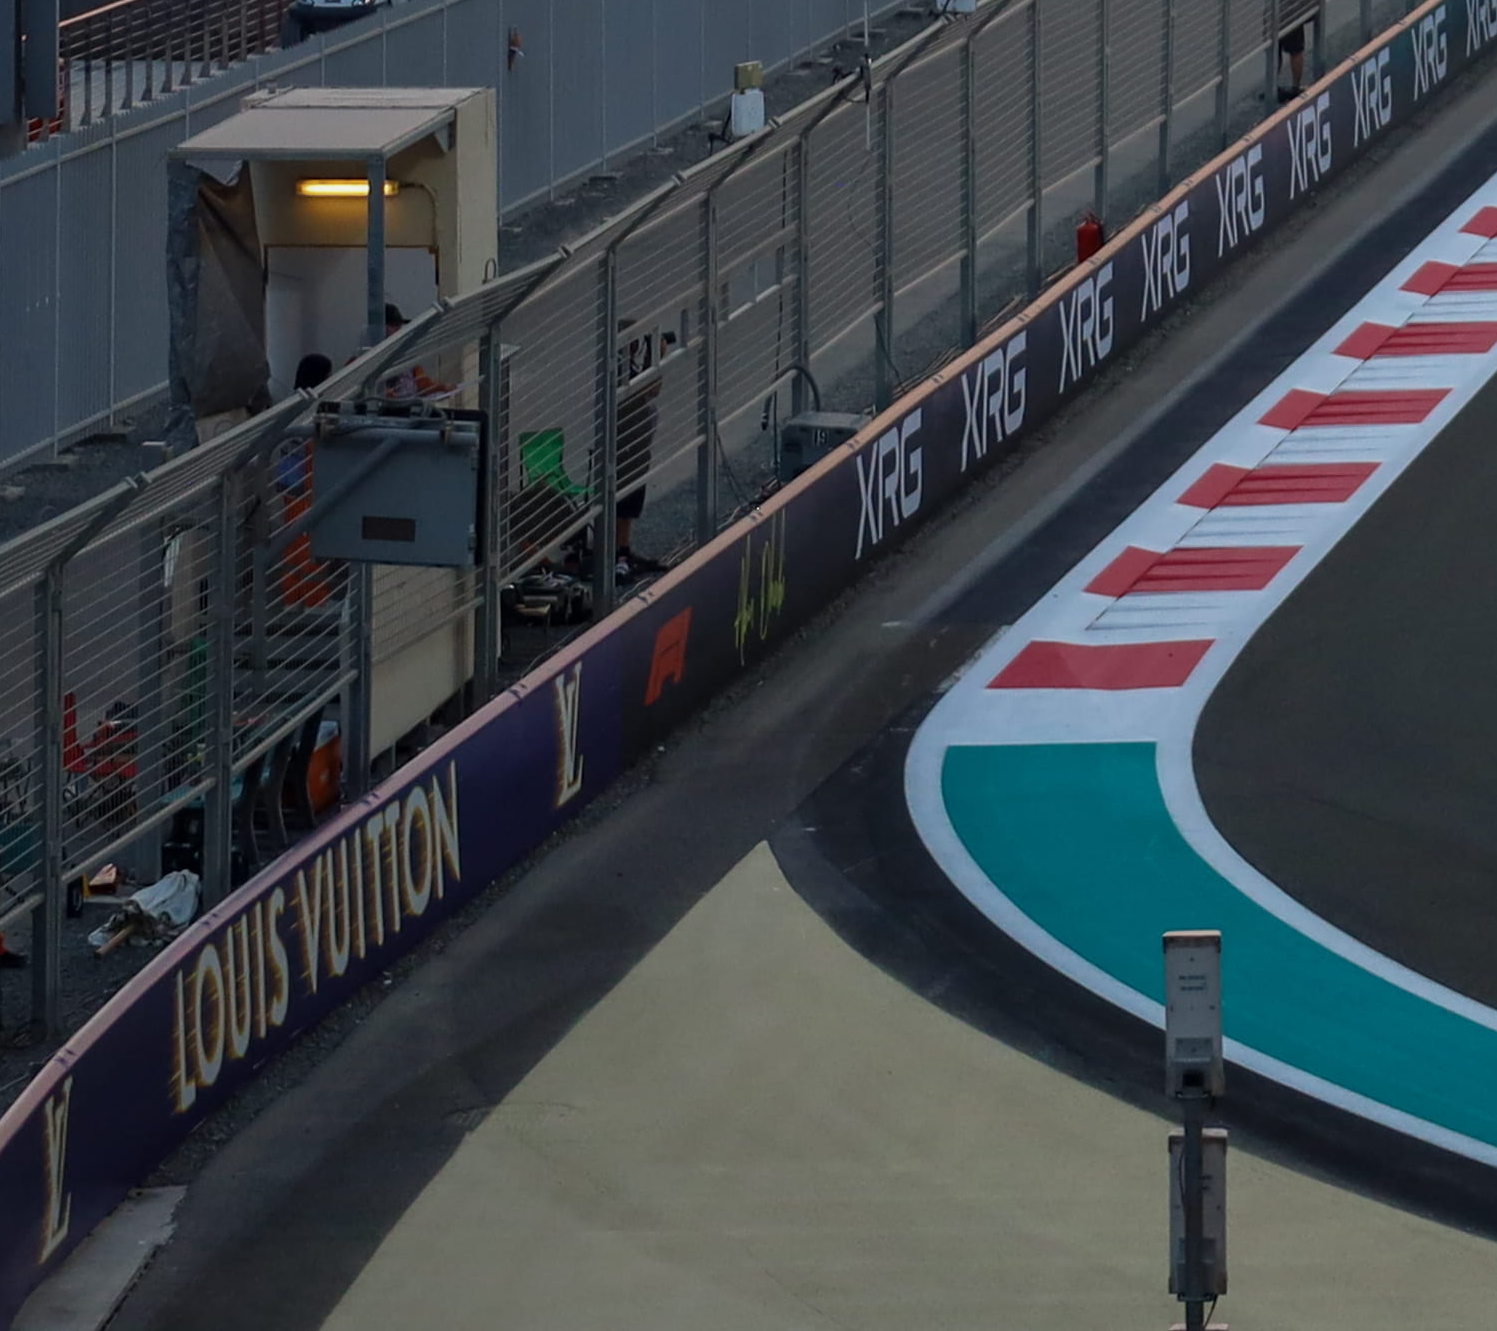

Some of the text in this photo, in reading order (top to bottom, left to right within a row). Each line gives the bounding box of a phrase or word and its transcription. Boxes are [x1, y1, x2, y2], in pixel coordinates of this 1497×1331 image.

[1351, 46, 1392, 148] XRG
[1410, 3, 1449, 101] XRG
[1215, 142, 1265, 258] XRG
[1286, 90, 1333, 200] XRG
[1140, 199, 1191, 323] XRG
[1058, 259, 1115, 394] XRG
[959, 330, 1027, 473] XRG
[854, 406, 923, 561] XRG
[171, 759, 462, 1115] LOUIS VUITTON
